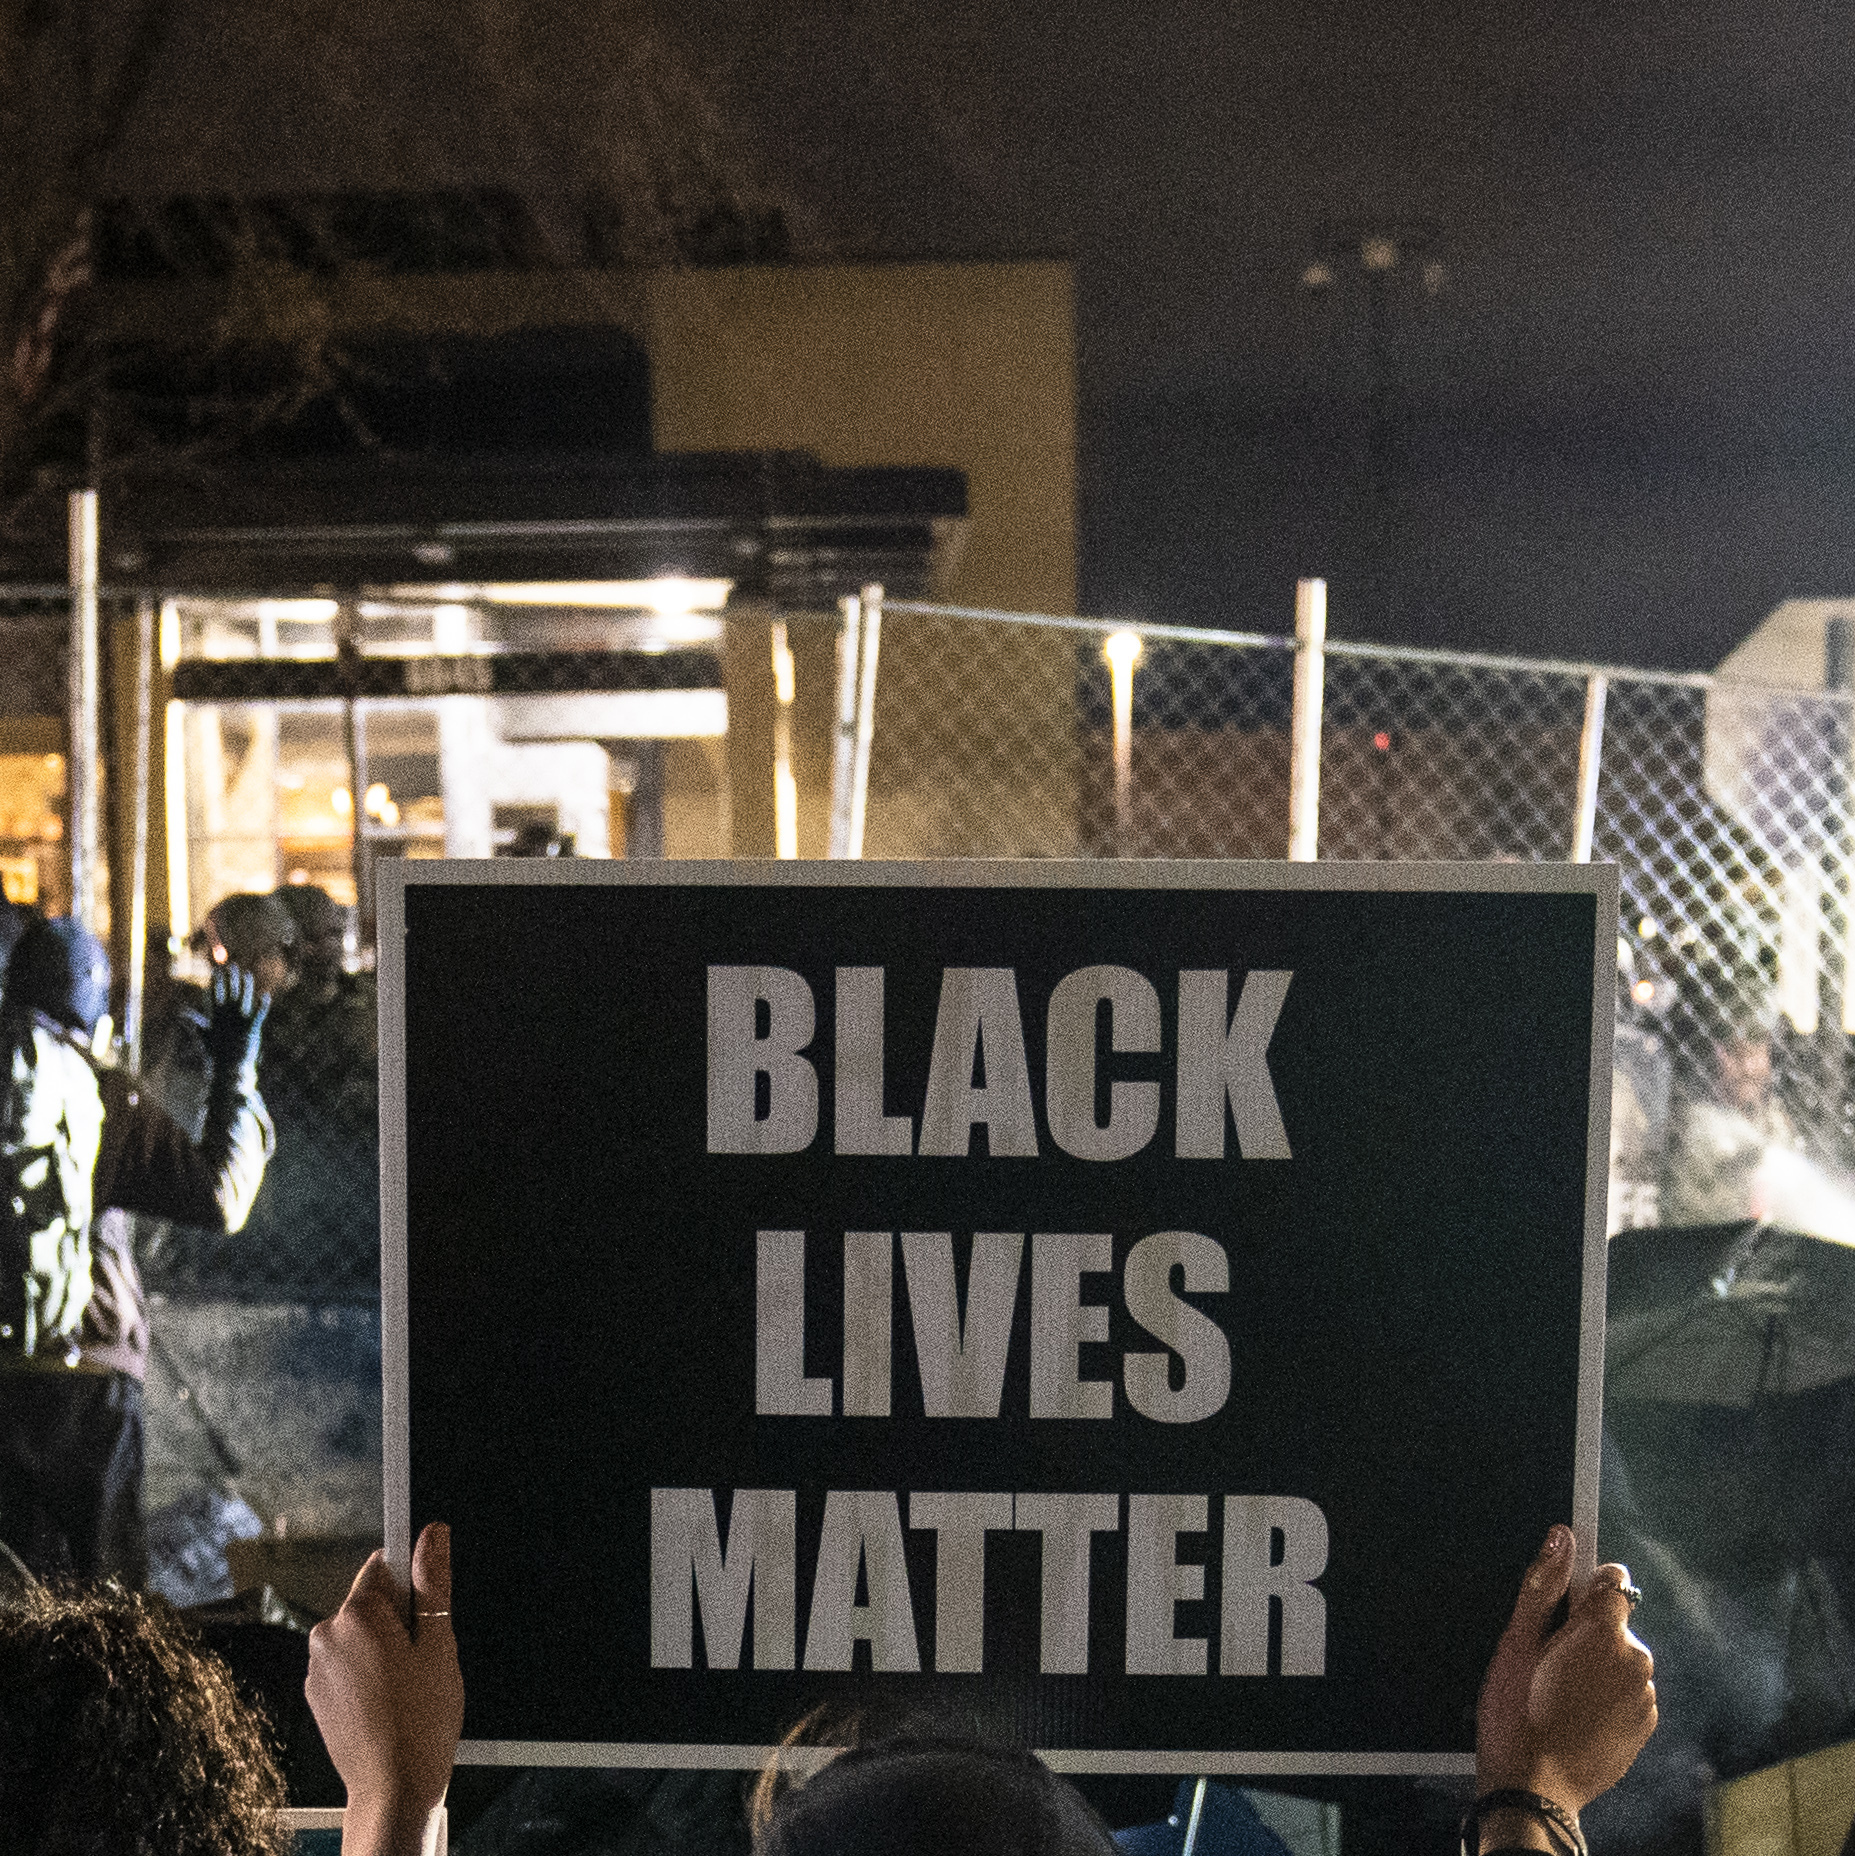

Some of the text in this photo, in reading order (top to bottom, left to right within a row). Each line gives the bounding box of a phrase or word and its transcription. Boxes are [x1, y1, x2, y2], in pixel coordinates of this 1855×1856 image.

[706, 963, 1296, 1162] BLACK
[754, 1229, 1233, 1424] LIVES
[649, 1486, 1332, 1677] MATTER
